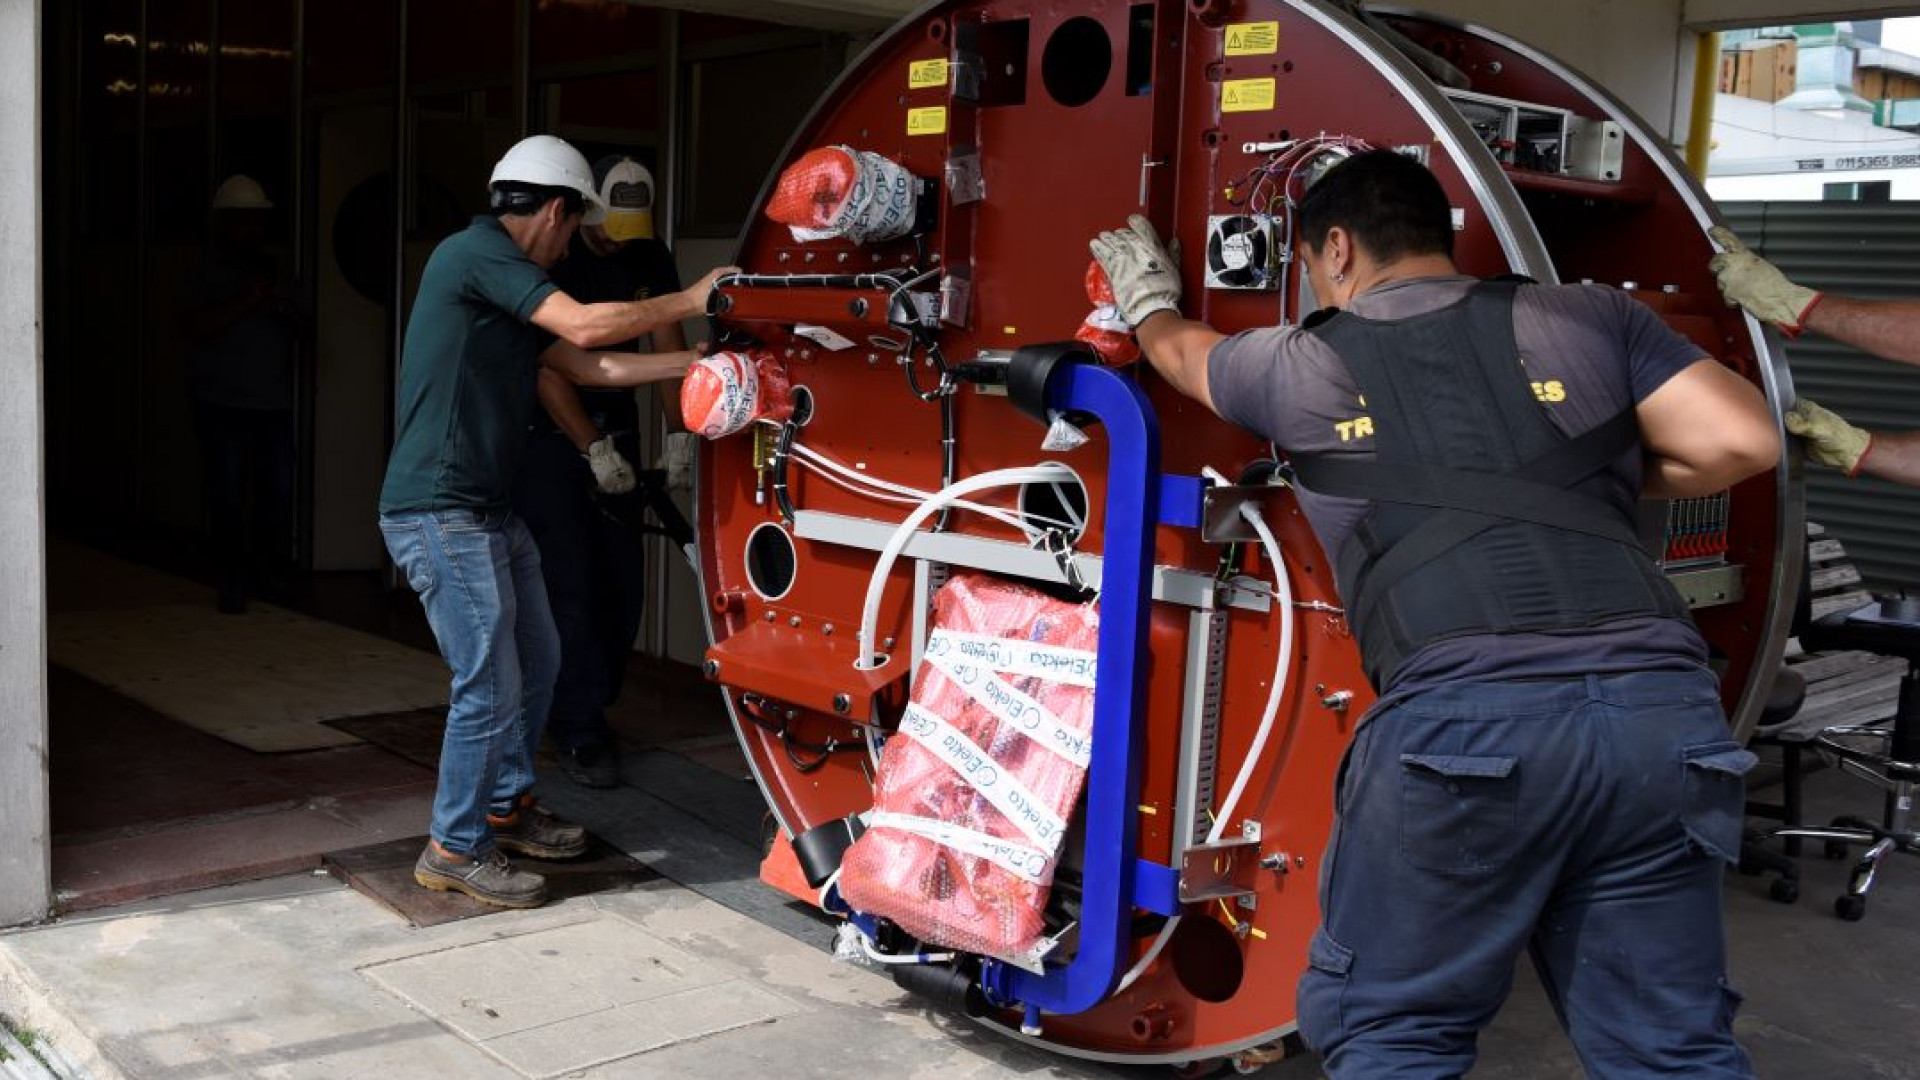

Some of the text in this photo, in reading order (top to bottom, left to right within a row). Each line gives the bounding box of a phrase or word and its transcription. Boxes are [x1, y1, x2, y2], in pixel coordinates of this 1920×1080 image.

[1030, 652, 1087, 674] Elekta
[985, 681, 1023, 717] Elekta
[943, 735, 983, 773] Elekta
[1009, 791, 1055, 838] Elekta
